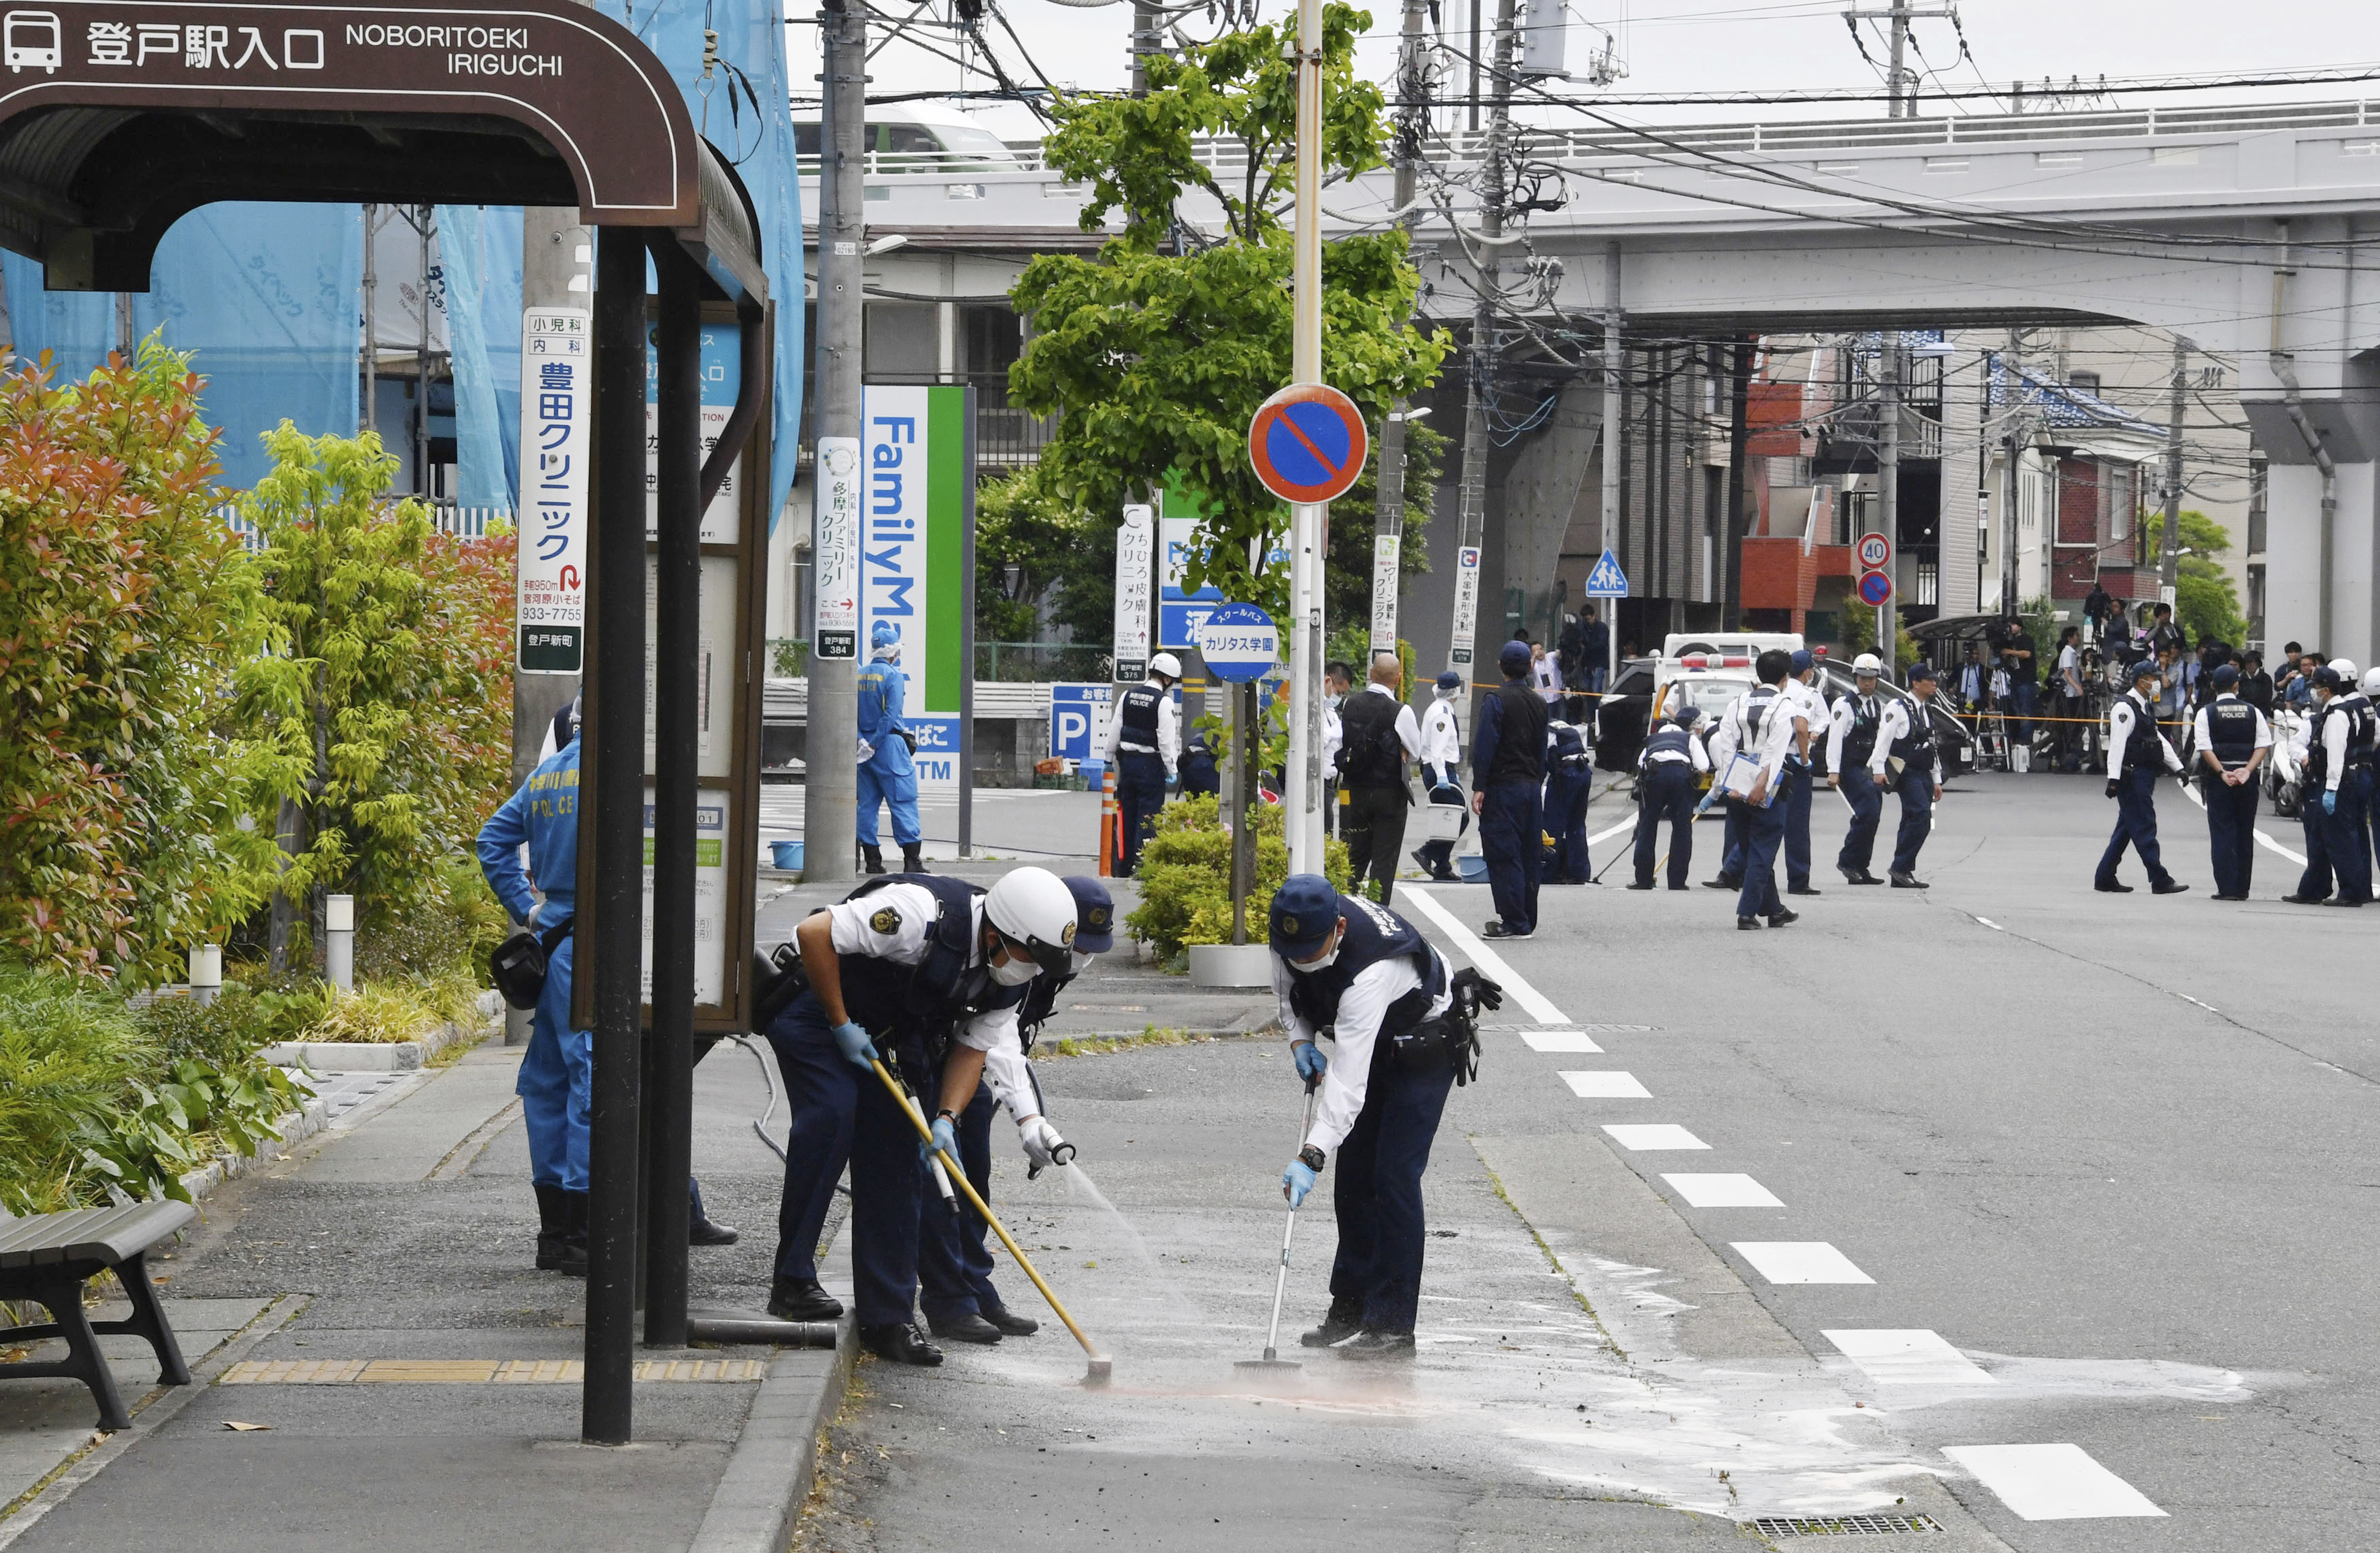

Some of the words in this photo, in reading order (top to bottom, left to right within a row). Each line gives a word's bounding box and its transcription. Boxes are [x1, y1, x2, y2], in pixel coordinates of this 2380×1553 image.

[87, 22, 324, 70] 登戸駅入口
[346, 24, 528, 49] NOBORITOEKI
[448, 53, 562, 76] IRIGUCHI
[534, 317, 581, 333] 小児科
[537, 362, 574, 561] 豊田クリニック
[833, 482, 848, 580] 多摩ファミリー
[821, 515, 833, 587] クリニック
[1864, 544, 1884, 559] 40
[1122, 533, 1135, 611] クリニック
[524, 594, 580, 605] 宿河原小そば
[523, 607, 581, 621] 933-7755
[1217, 609, 1262, 624] スクールバス
[528, 634, 573, 647] 登戸新町
[830, 646, 846, 654] 384
[1206, 637, 1273, 652] カリタス学園
[1058, 712, 1087, 751] P
